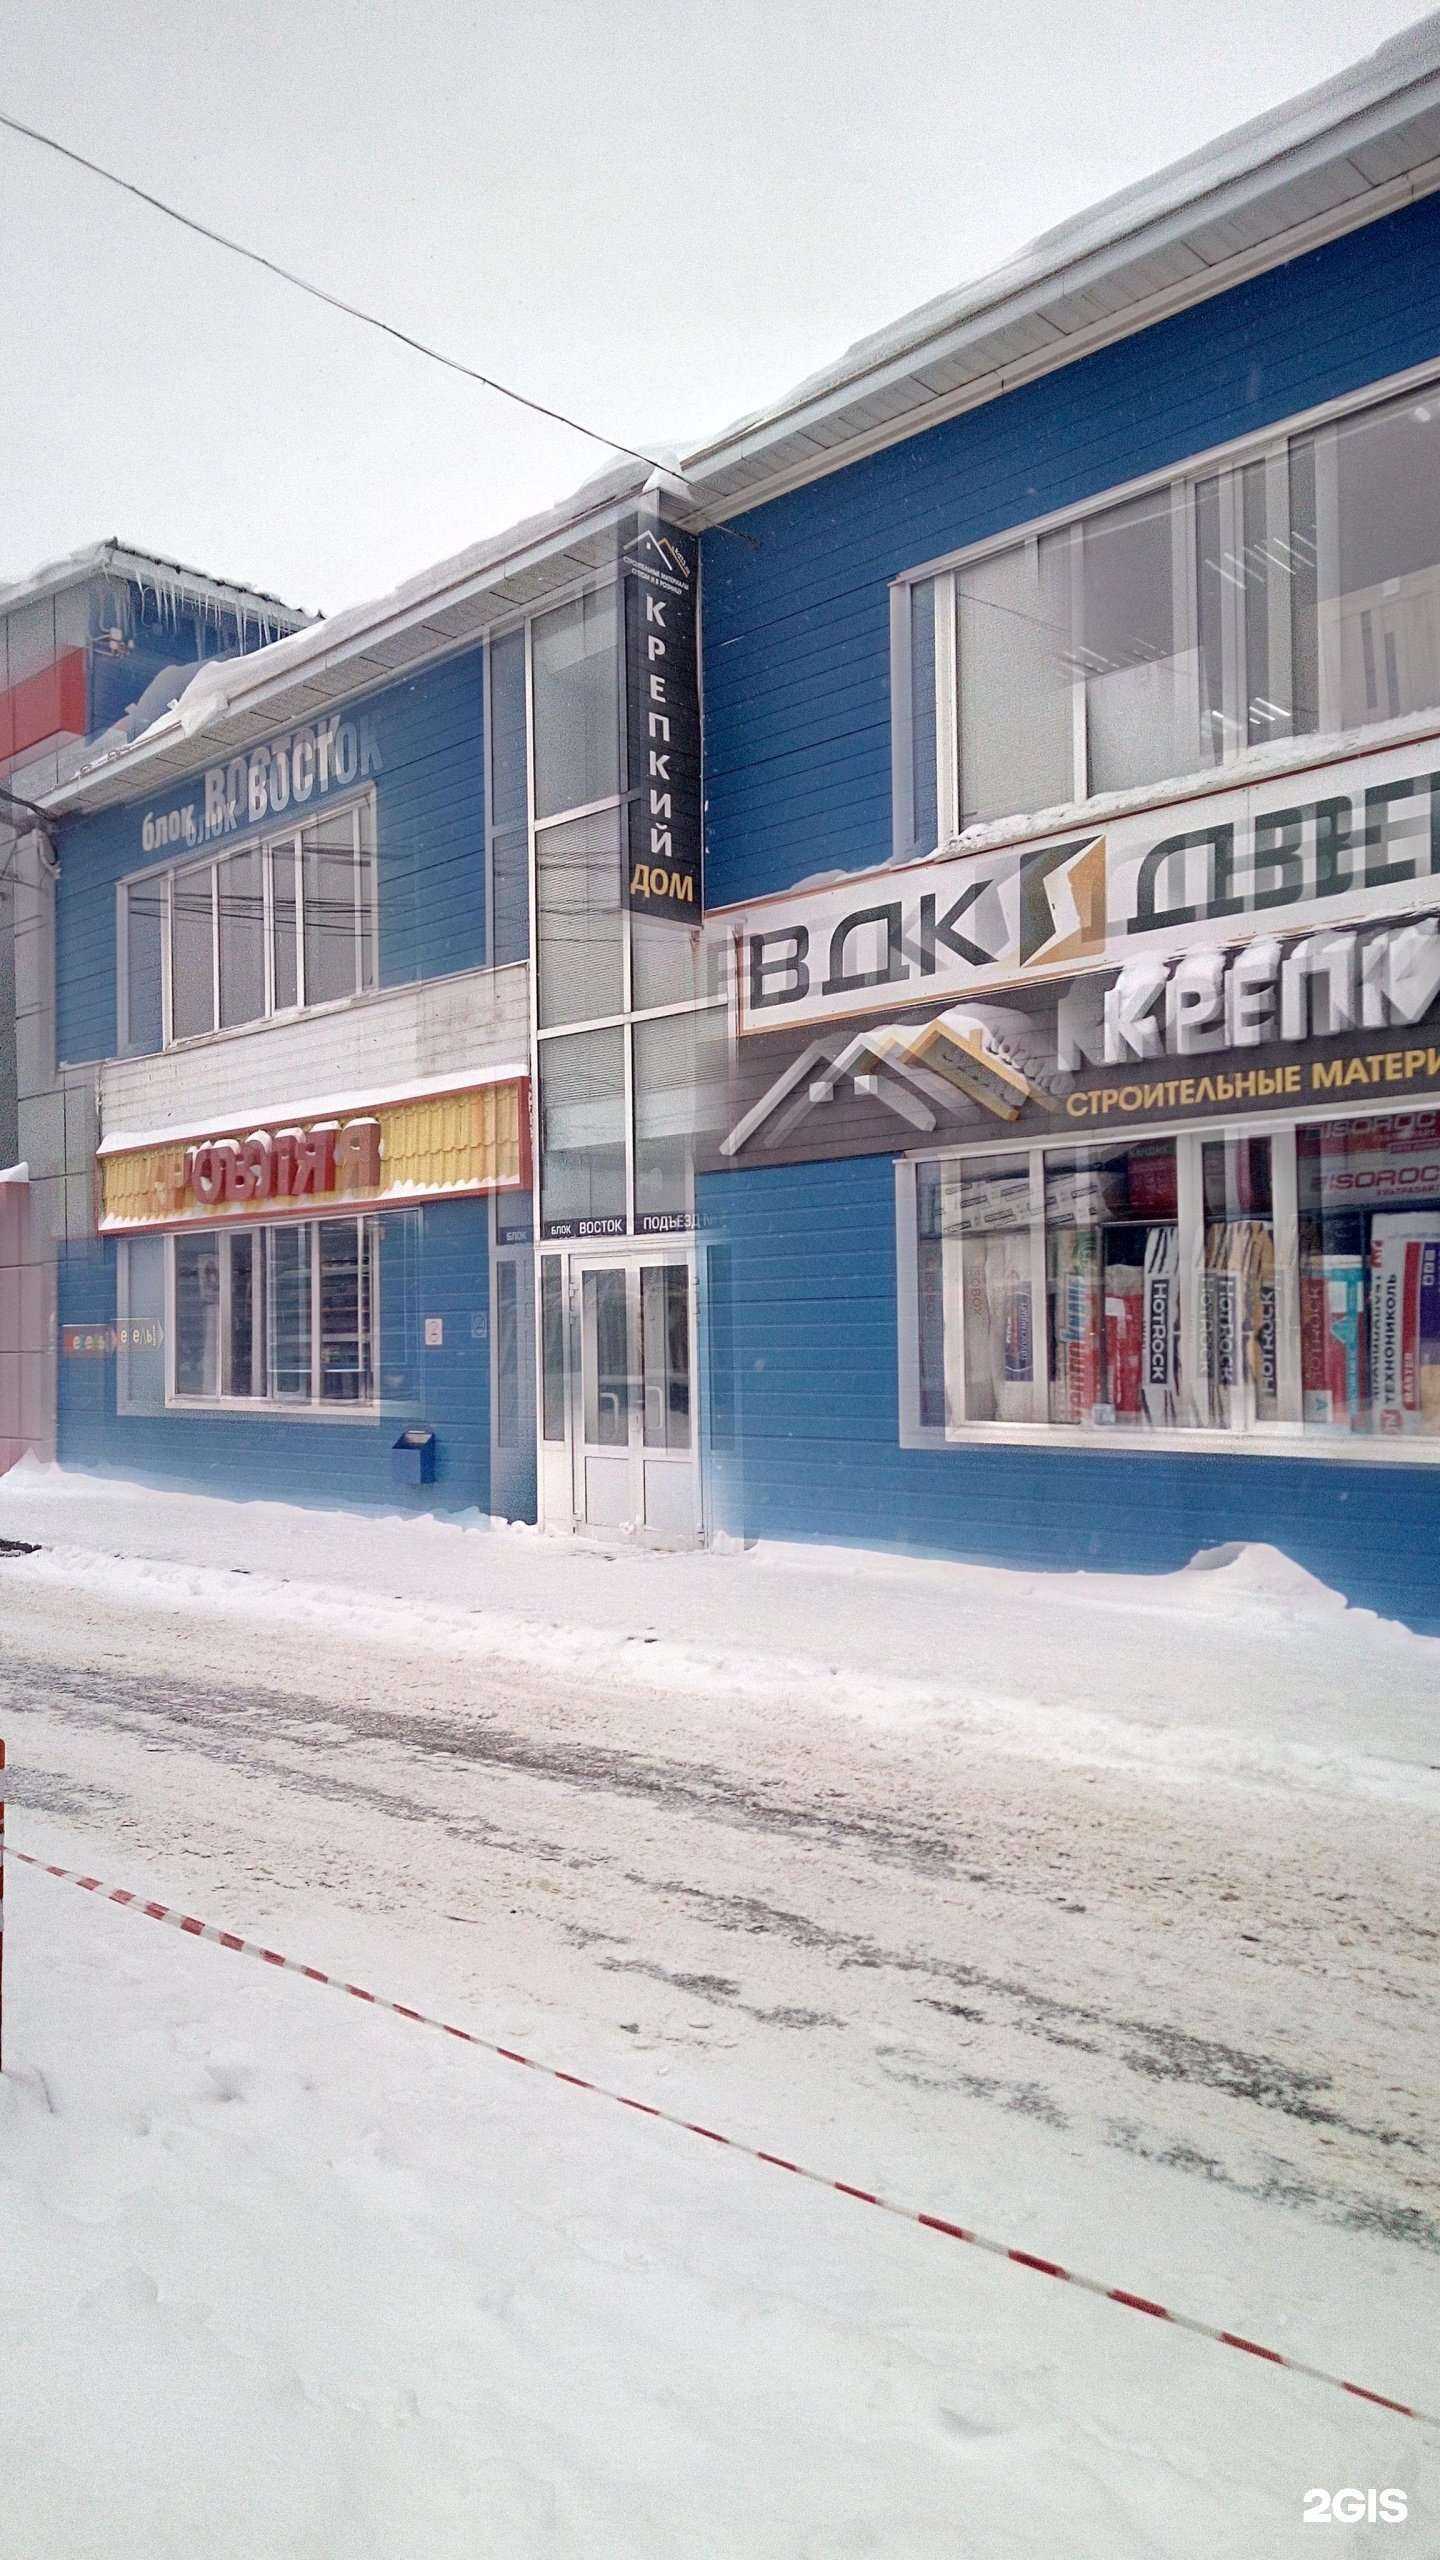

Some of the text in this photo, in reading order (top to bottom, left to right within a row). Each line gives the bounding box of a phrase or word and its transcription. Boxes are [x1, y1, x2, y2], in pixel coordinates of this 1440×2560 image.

[645, 593, 673, 858] КРЕПКИЙ
[629, 862, 694, 904] ДОМ
[1066, 1064, 1300, 1117] СТРОИТЕЛЬНЫЕ
[551, 1224, 571, 1236] БЛОК
[579, 1218, 623, 1234] ВОСТОК
[1152, 1283, 1168, 1381] HOTROCK
[1384, 1273, 1398, 1404] ТЕХНОНИКОЛЬ
